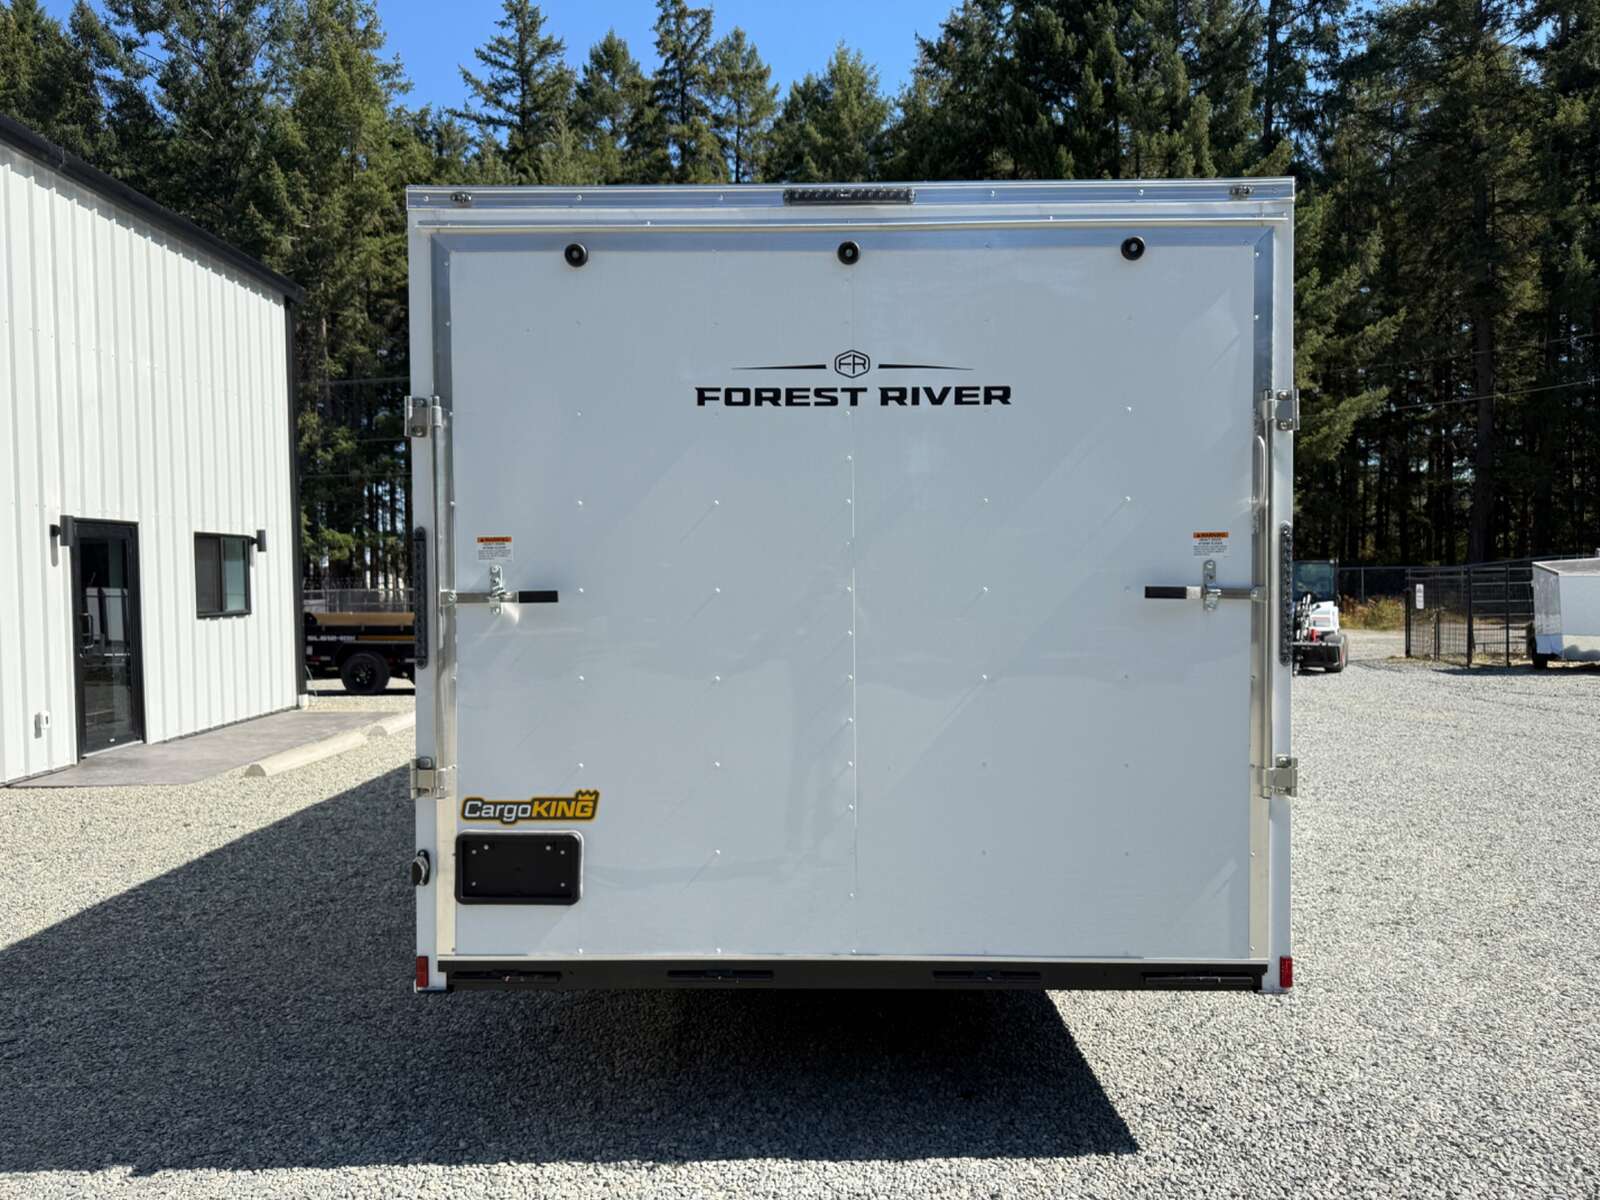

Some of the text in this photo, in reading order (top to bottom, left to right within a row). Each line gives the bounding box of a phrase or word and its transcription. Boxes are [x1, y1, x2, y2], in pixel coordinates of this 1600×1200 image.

[839, 354, 866, 374] FR
[695, 385, 1012, 407] FOREST RIVER
[464, 800, 594, 821] CargoKING
